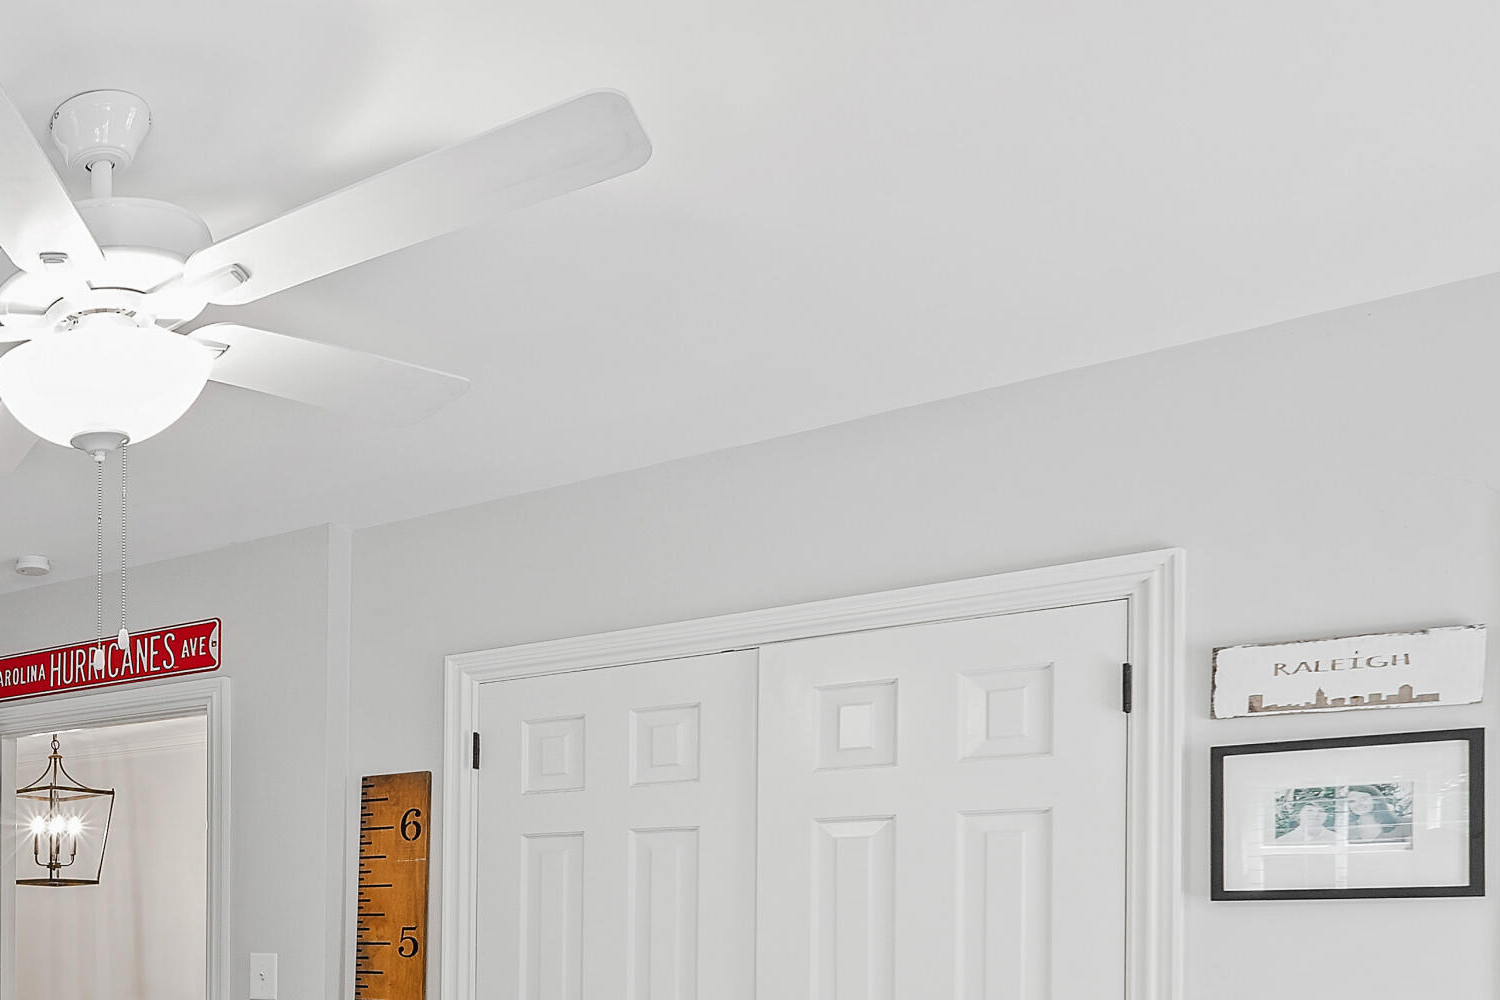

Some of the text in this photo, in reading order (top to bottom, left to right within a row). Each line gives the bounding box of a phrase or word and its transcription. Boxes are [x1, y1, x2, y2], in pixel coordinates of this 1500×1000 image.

[181, 636, 206, 658] AVE
[400, 808, 422, 842] 6
[398, 926, 419, 958] 5
